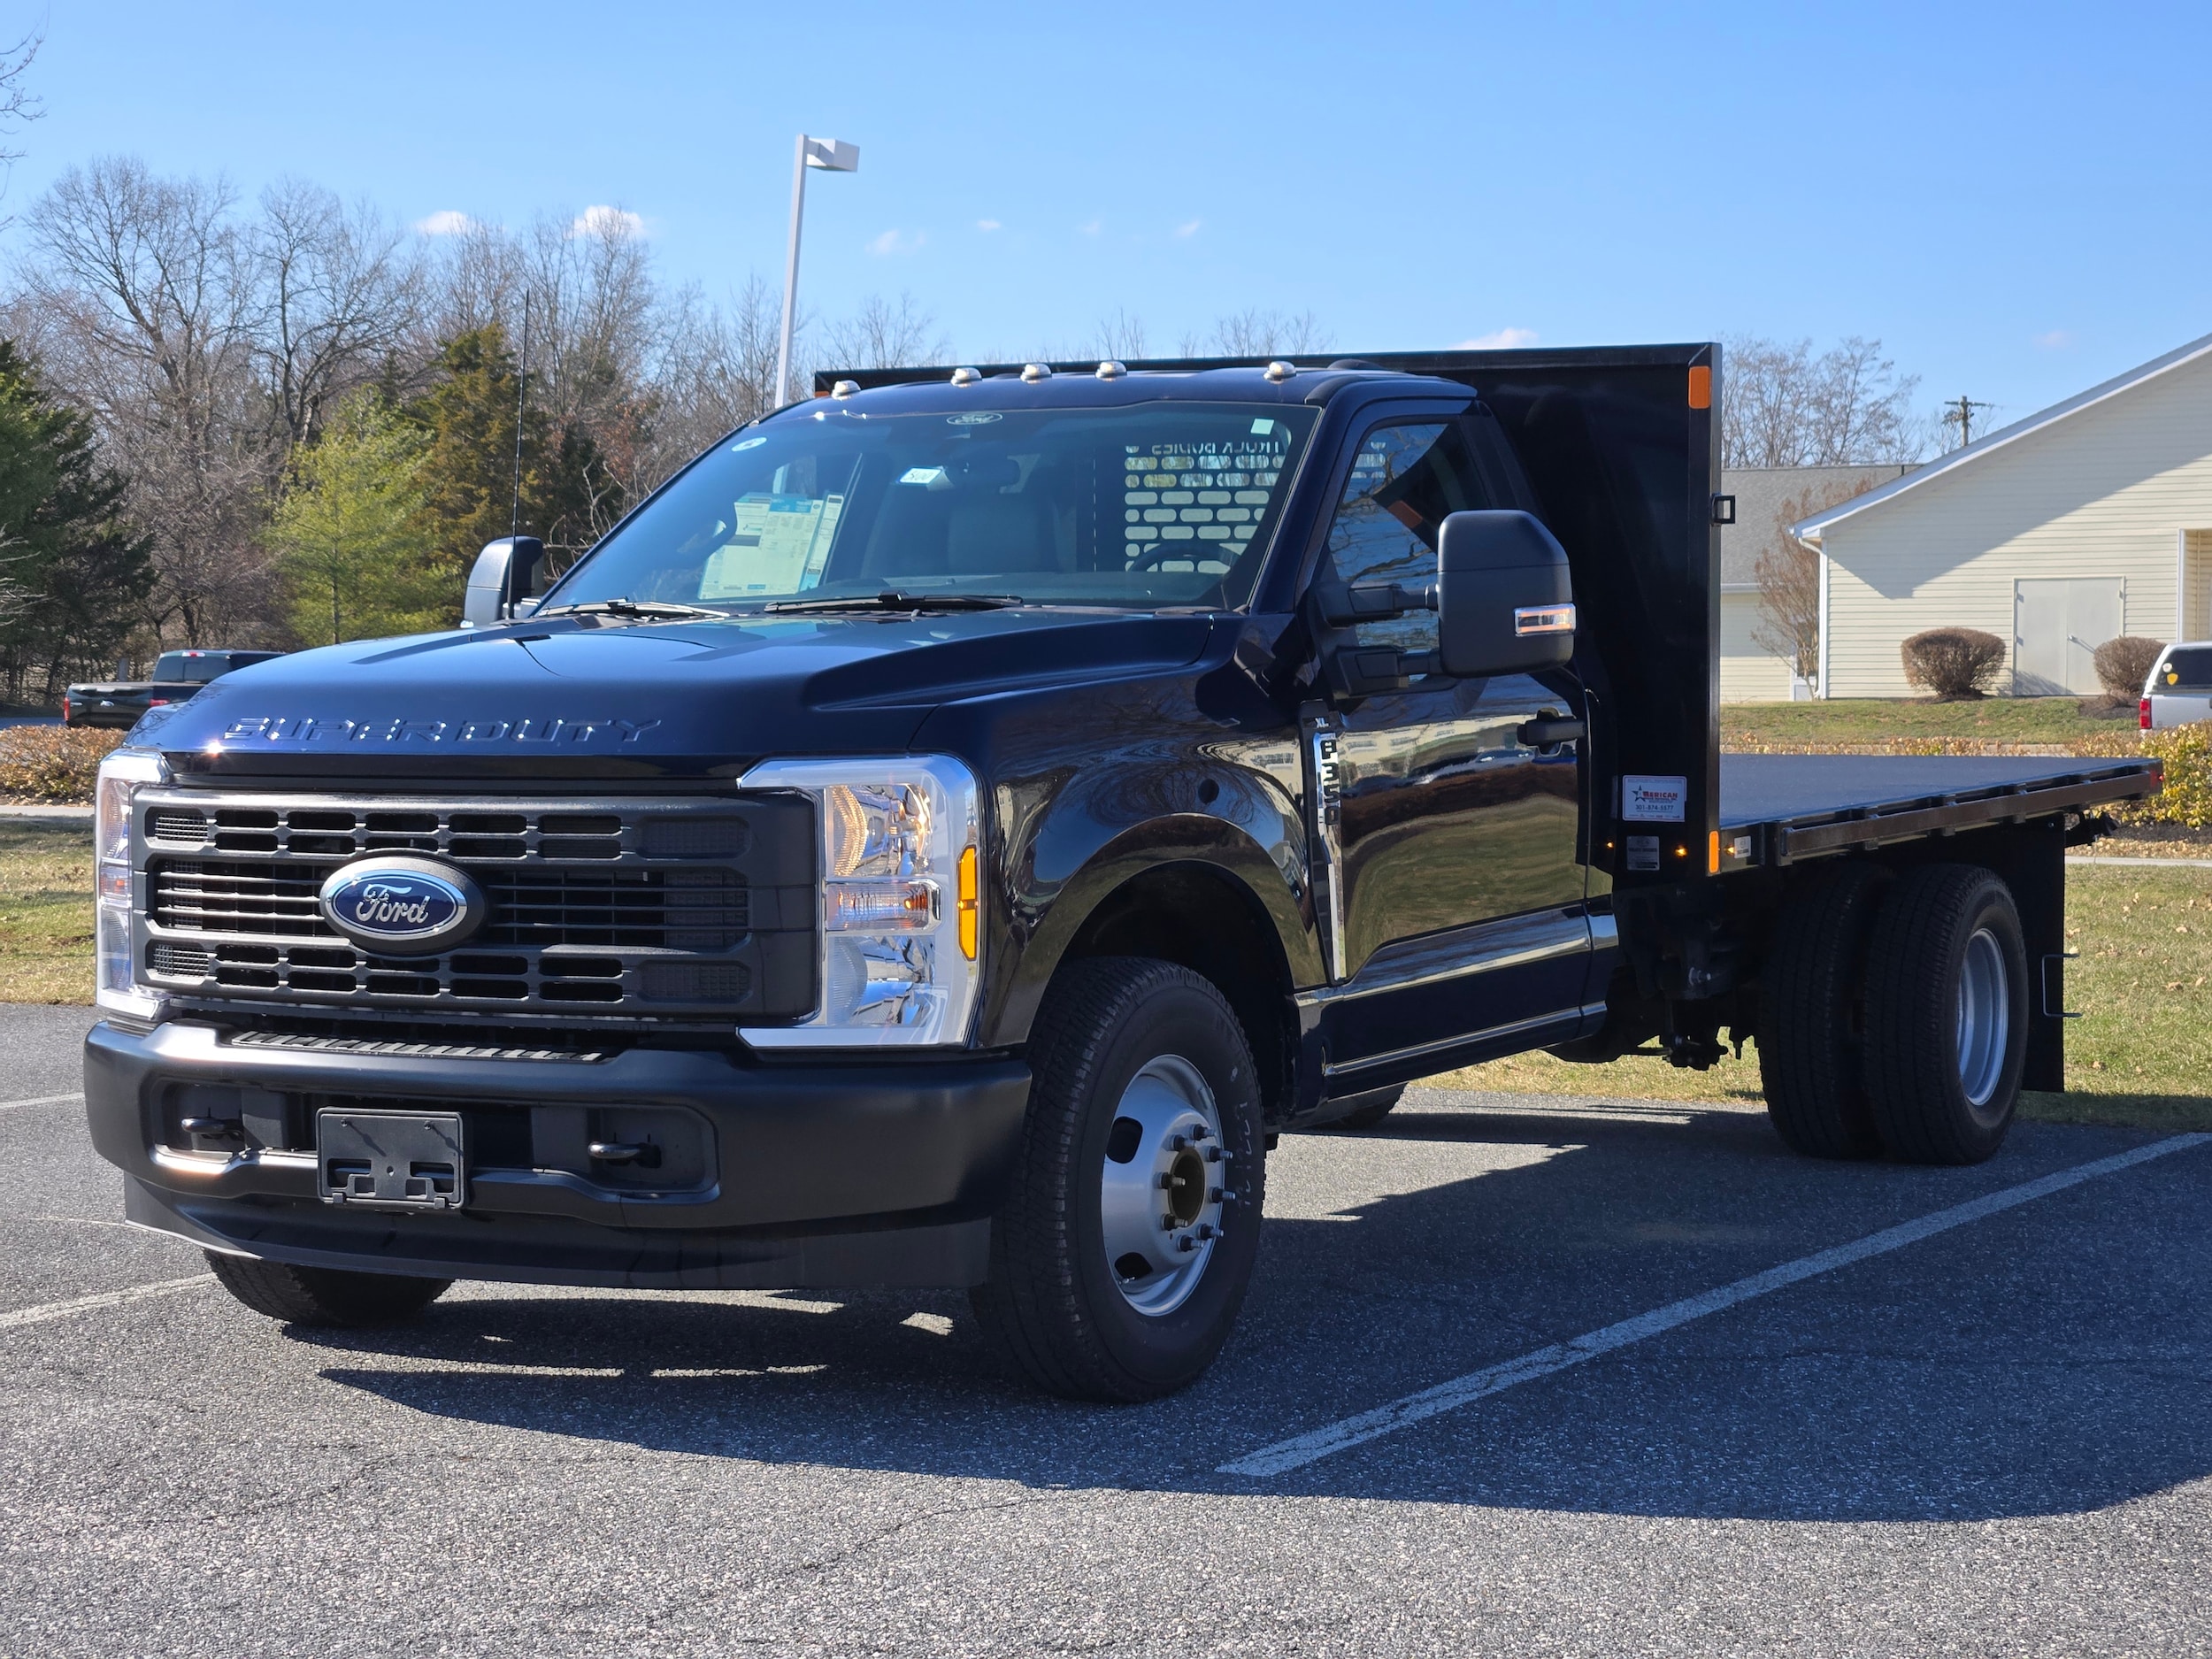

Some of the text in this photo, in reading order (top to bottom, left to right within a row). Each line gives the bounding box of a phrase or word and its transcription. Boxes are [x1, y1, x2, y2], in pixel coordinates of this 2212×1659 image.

[223, 716, 663, 743] SUPER DUTY
[1314, 717, 1330, 729] XL
[355, 883, 431, 925] Ford
